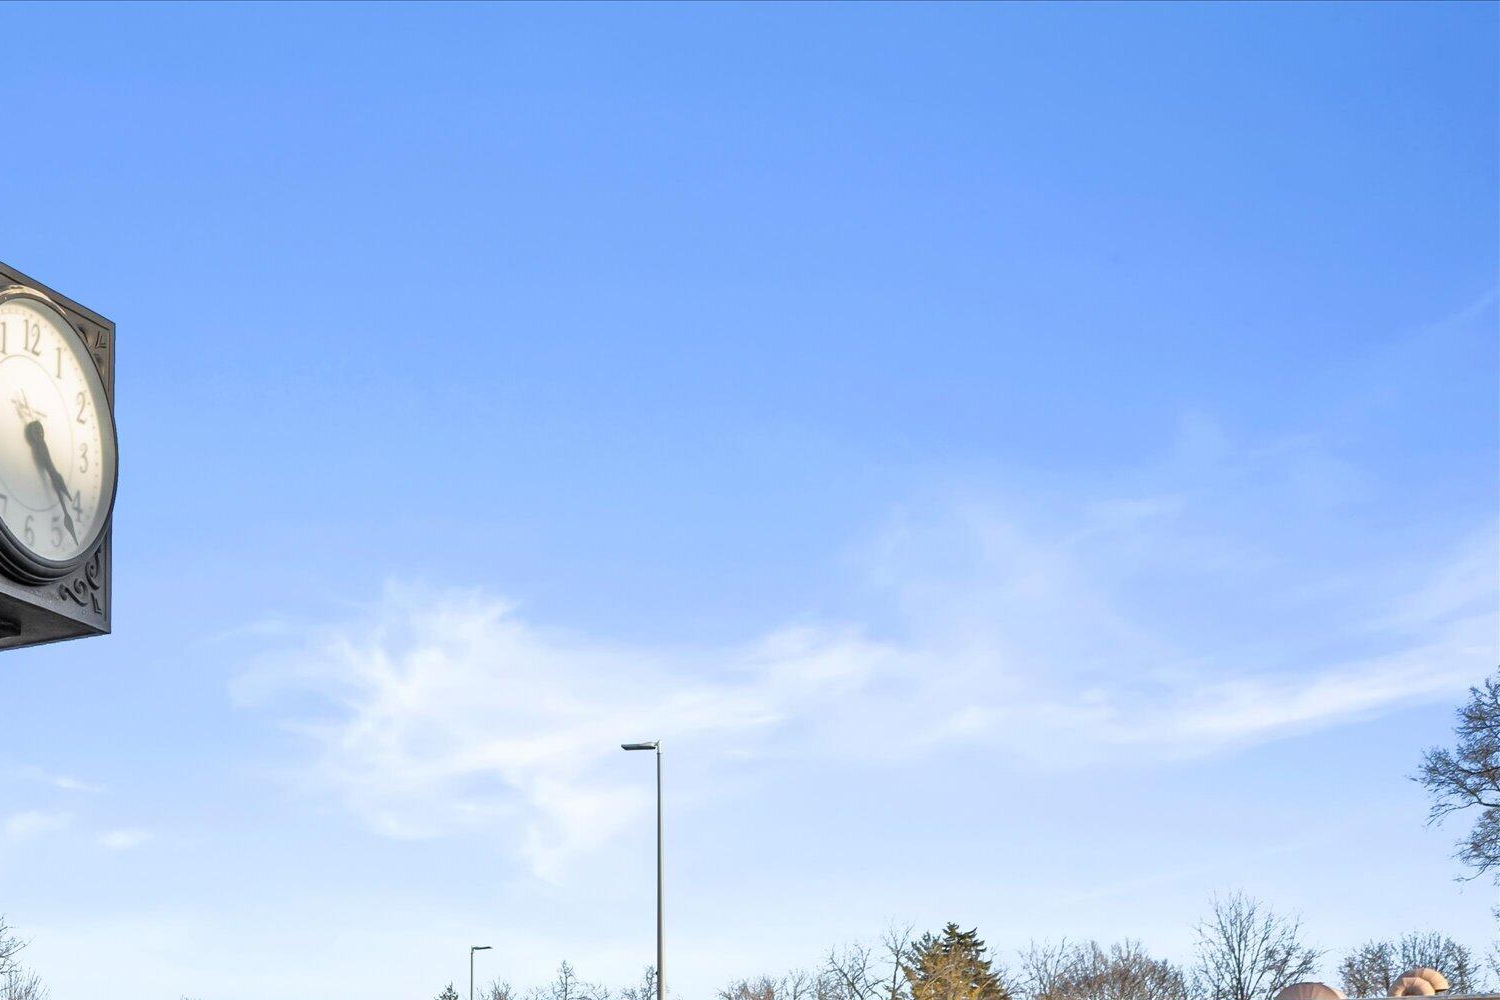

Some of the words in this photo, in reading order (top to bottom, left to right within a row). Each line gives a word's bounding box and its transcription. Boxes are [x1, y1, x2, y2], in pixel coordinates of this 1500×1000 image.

[23, 319, 42, 356] 12
[55, 347, 64, 380] 1
[76, 392, 86, 424] 2
[79, 443, 89, 474] 3
[72, 490, 83, 523] 4
[25, 514, 34, 546] 6
[52, 516, 63, 547] 5
